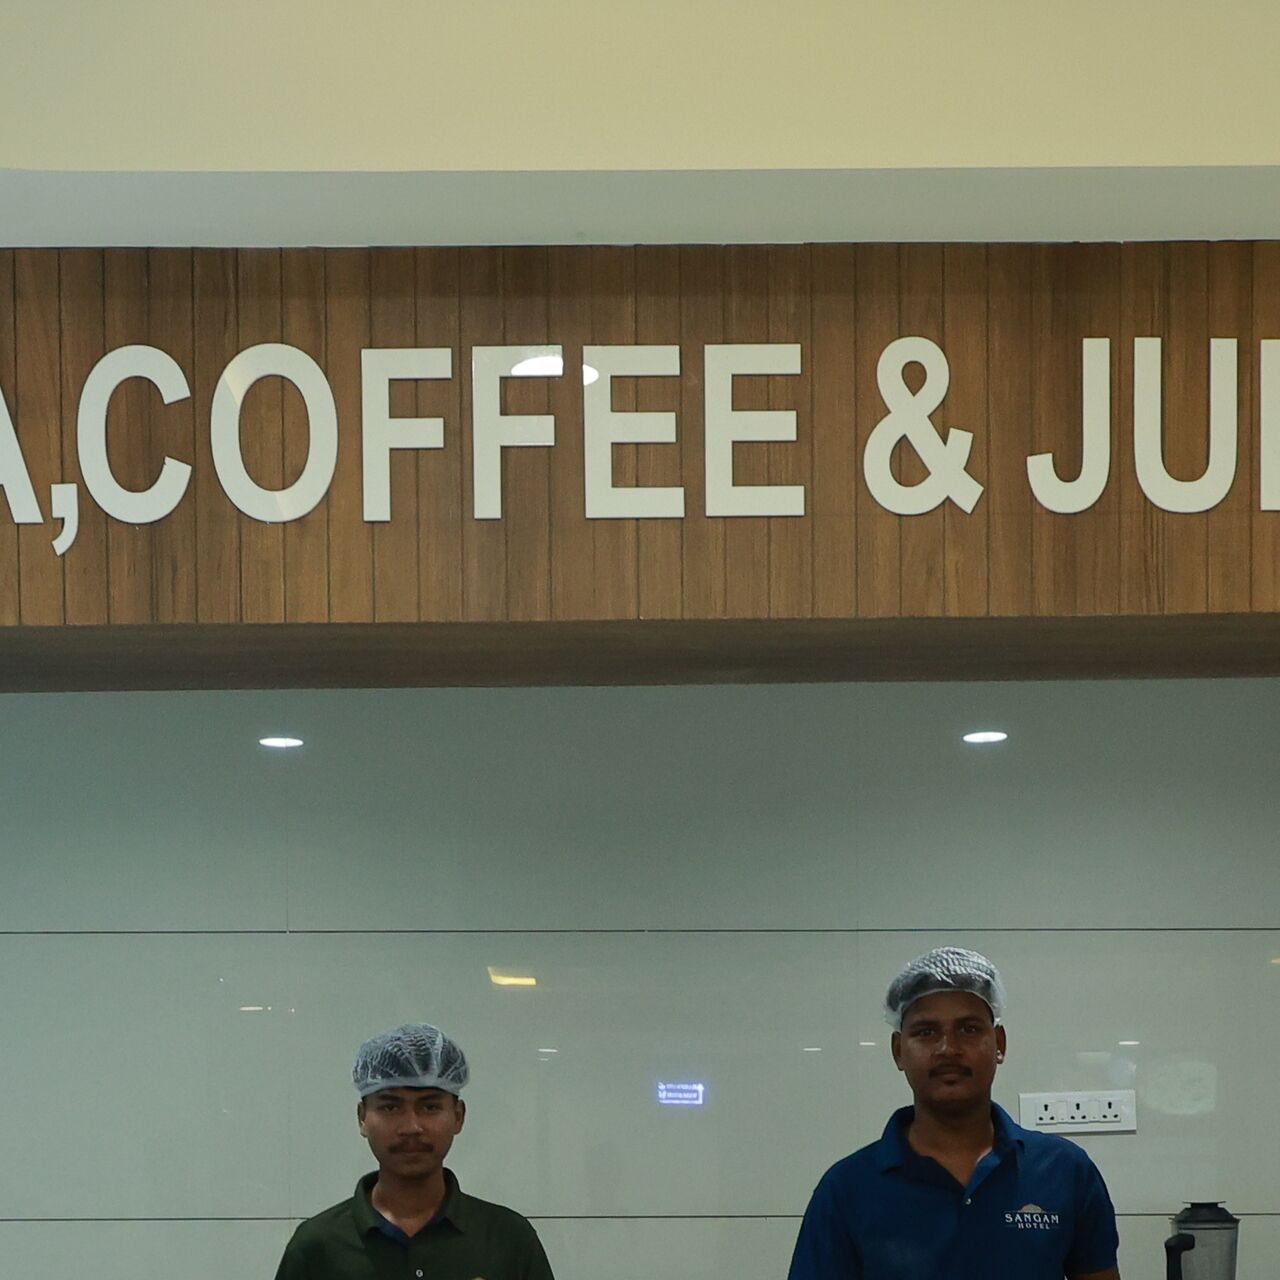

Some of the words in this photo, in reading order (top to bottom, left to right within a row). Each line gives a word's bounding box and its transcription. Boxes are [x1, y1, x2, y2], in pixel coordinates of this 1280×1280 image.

[862, 336, 985, 515] &
[1005, 1213, 1059, 1224] SANGAM
[1018, 1222, 1050, 1230] HOTEL
